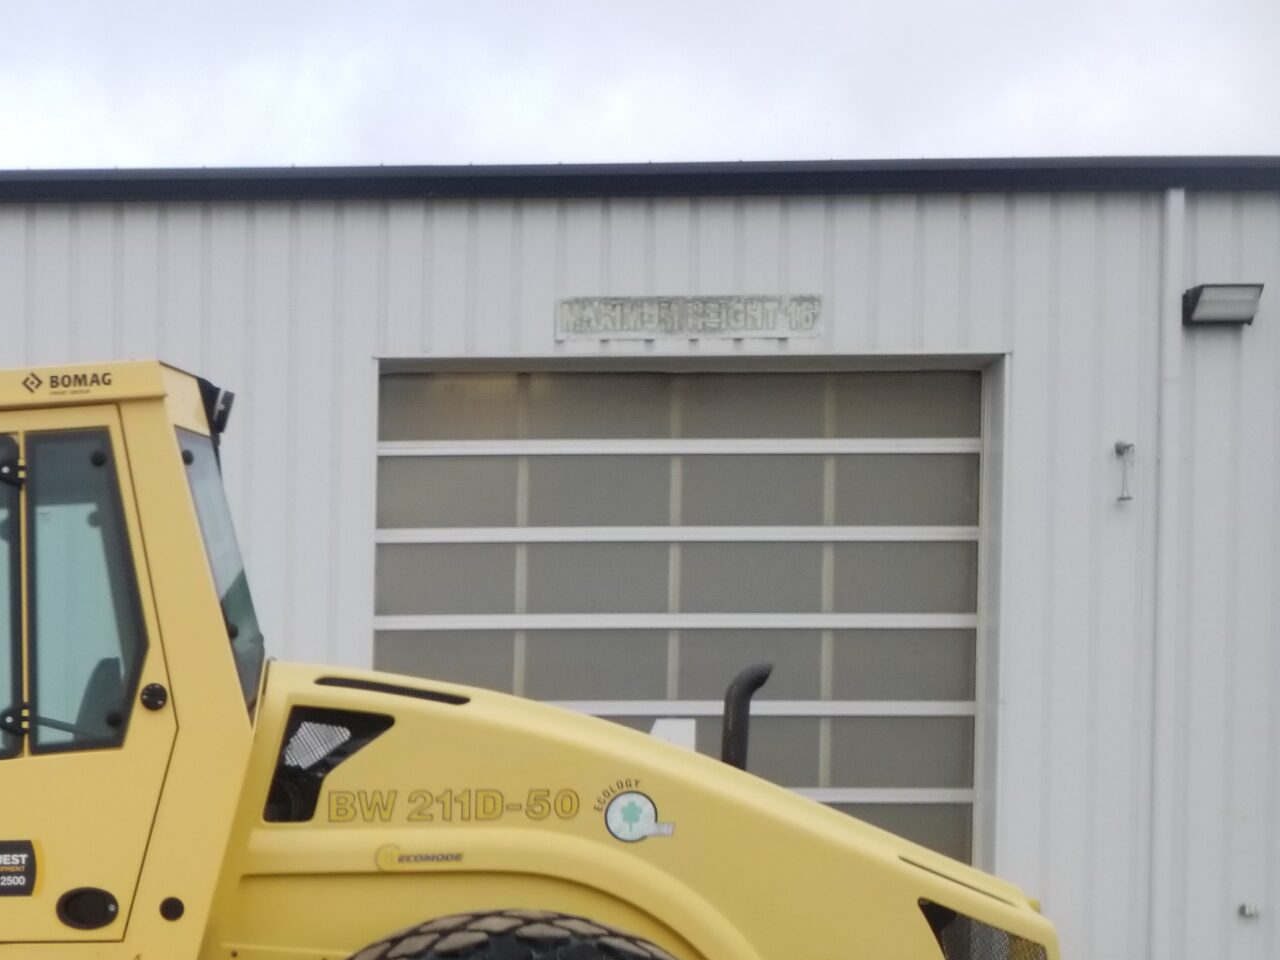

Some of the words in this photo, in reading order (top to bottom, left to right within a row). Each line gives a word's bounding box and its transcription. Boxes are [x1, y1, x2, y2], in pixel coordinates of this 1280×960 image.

[686, 300, 778, 331] HEIGHT
[49, 372, 112, 389] BOMAG
[327, 790, 398, 822] BW
[407, 788, 580, 822] 211D-50
[593, 777, 641, 812] ECOLOGY
